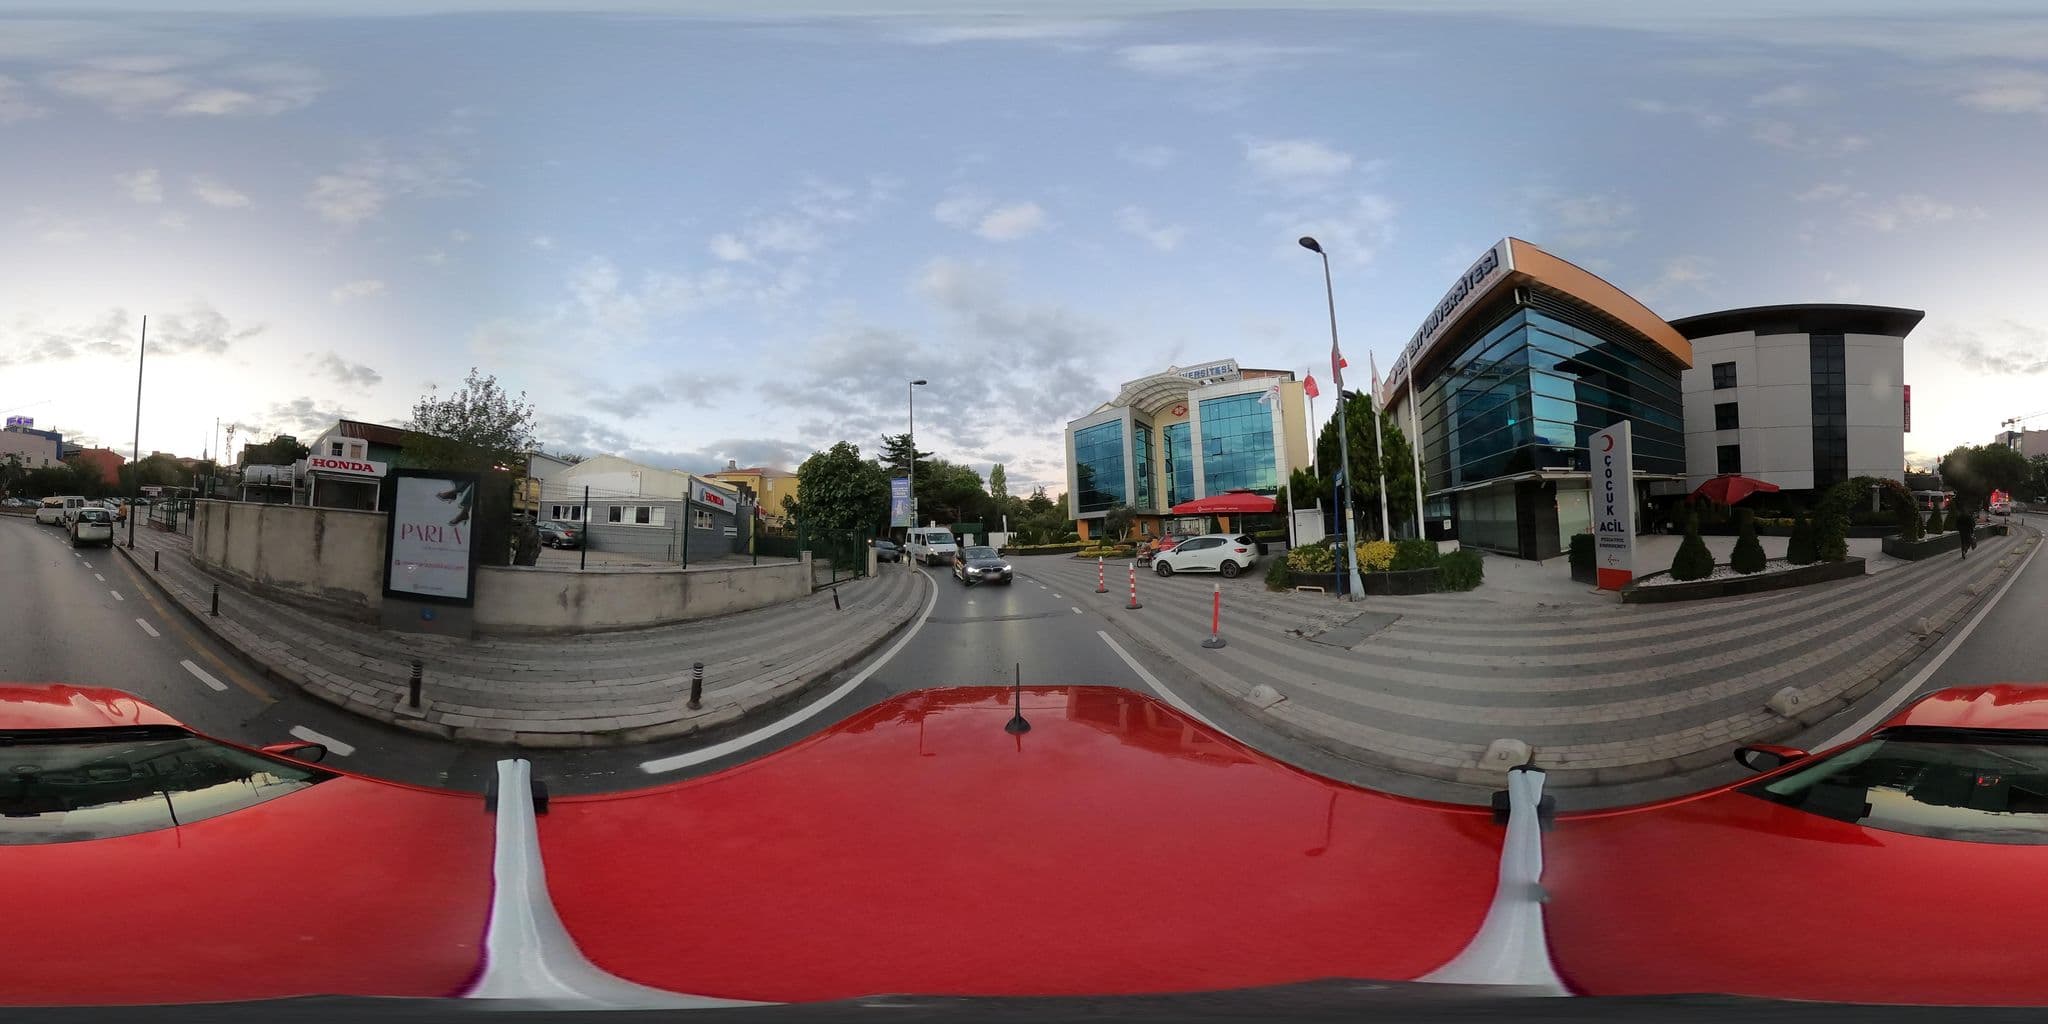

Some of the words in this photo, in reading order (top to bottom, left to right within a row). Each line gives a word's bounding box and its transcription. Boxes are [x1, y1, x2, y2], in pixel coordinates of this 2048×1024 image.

[312, 458, 375, 473] HONDA
[1604, 455, 1615, 517] ÇOCUK
[1599, 519, 1625, 533] ACİL
